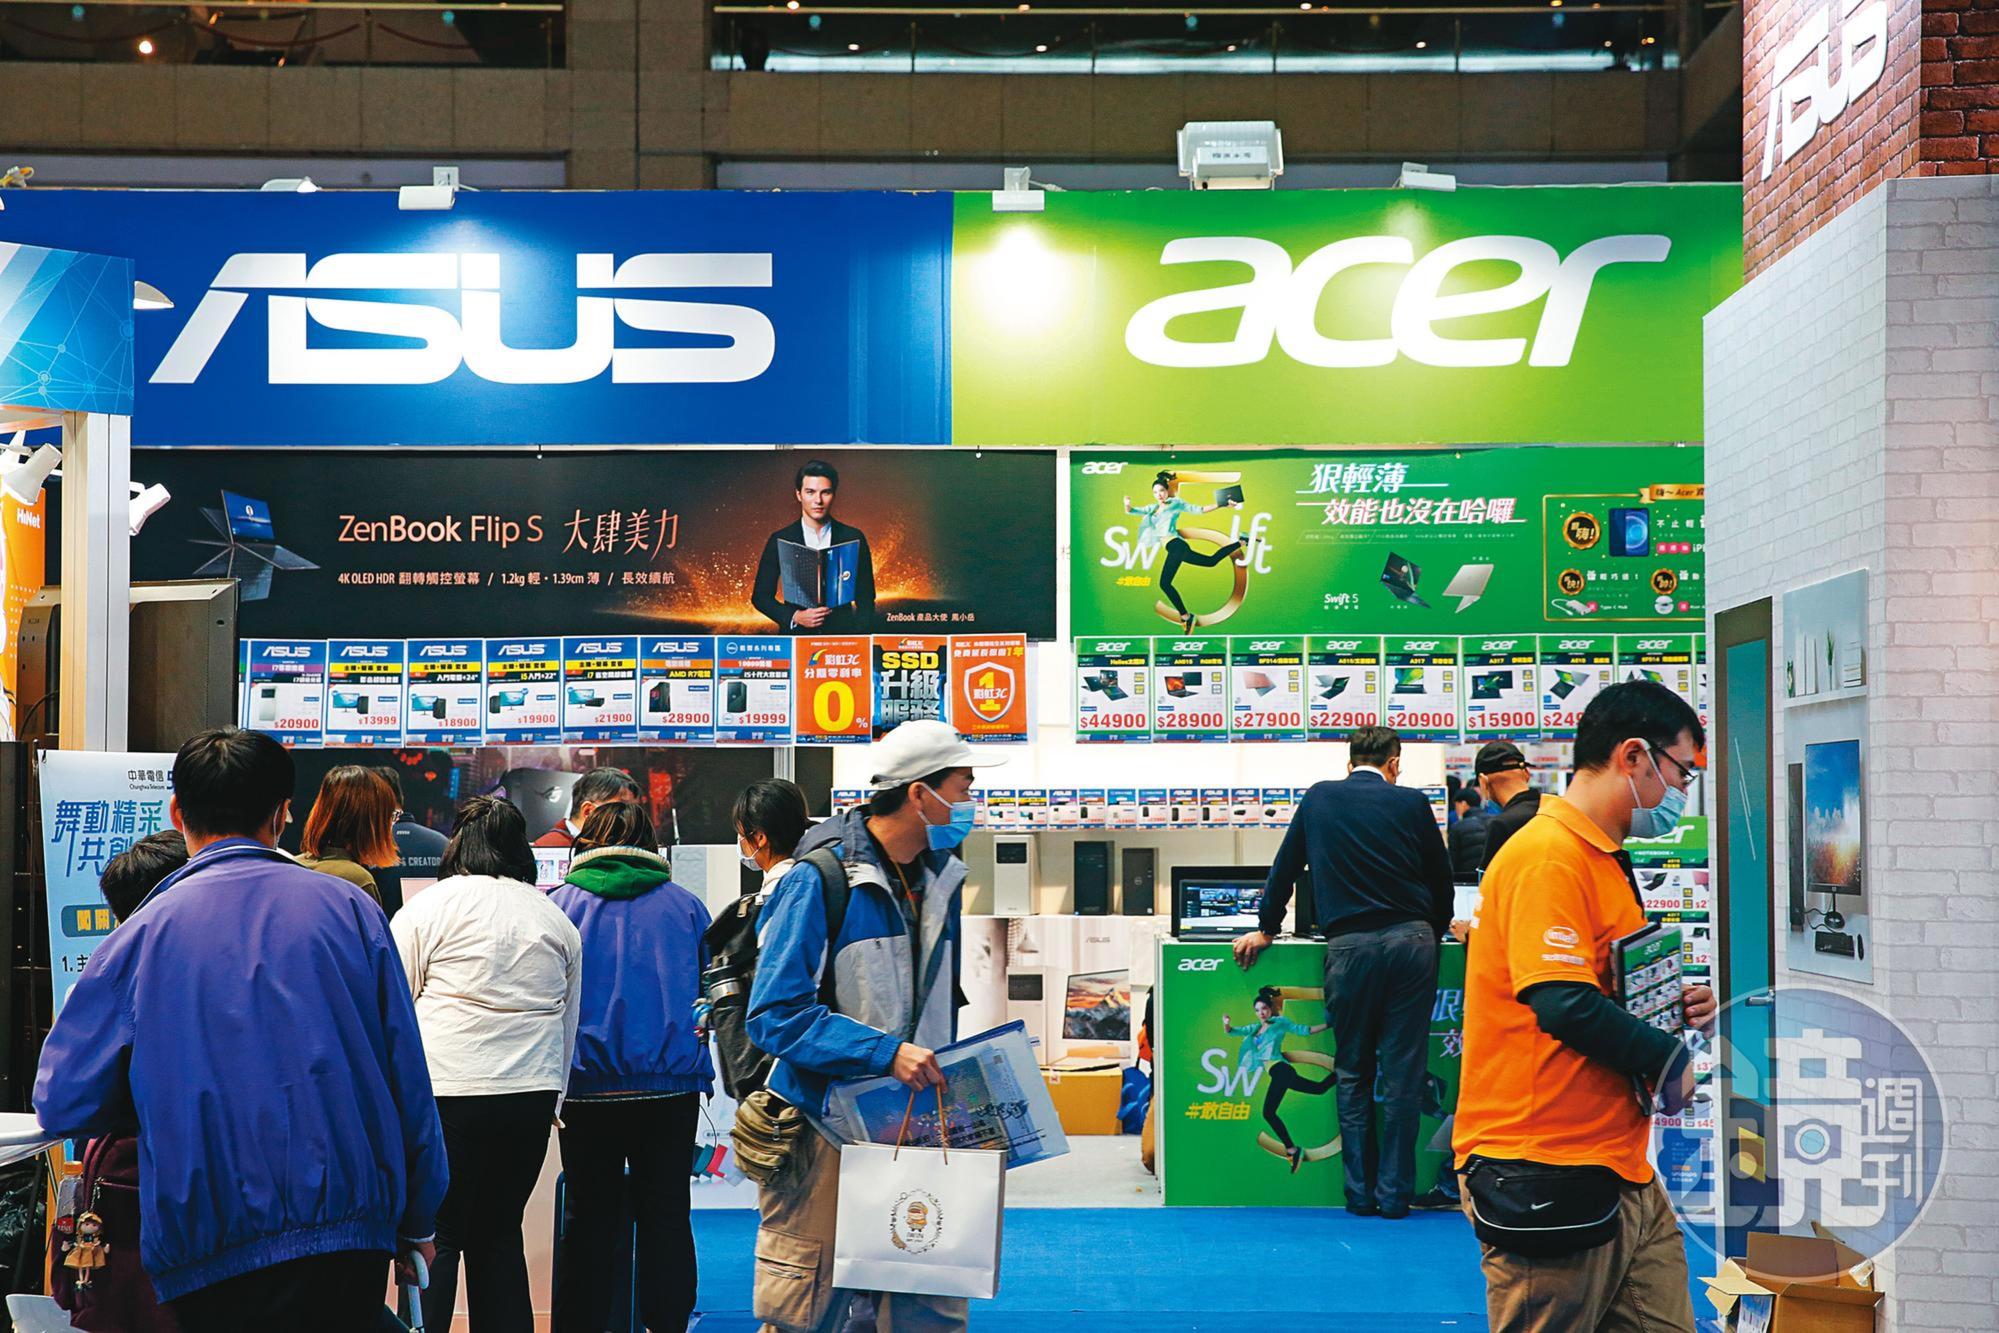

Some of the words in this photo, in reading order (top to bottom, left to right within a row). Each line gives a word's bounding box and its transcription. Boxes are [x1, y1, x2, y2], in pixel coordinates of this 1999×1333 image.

[1125, 234, 1672, 368] acer
[148, 253, 776, 385] ASUS
[1082, 461, 1128, 475] acer
[1321, 497, 1517, 525] 效能也沒在哈囉
[16, 508, 41, 529] HiNet
[338, 515, 461, 542] ZenBook
[471, 514, 520, 549] Flip
[527, 515, 543, 542] S
[563, 508, 679, 561] 大肆美力
[338, 574, 350, 584] 4K
[352, 574, 374, 584] OLED
[376, 574, 395, 584] HDR
[399, 572, 480, 585] 翻轉觸控螢幕
[501, 573, 525, 587] 1.2kg
[622, 573, 675, 585] 長效續航
[1324, 593, 1350, 604] Swift
[498, 644, 545, 655] ASUS
[575, 642, 622, 654] ASUS
[652, 642, 700, 653] ASUS
[1095, 642, 1131, 652] acer
[1172, 641, 1208, 651] acer
[1249, 641, 1285, 651] acer
[1326, 640, 1362, 650] acer
[1403, 641, 1440, 651] acer
[1481, 640, 1518, 650] acer
[1558, 639, 1595, 650] acer
[1637, 639, 1673, 650] acer
[262, 646, 311, 657] ASUS
[340, 646, 389, 657] ASUS
[419, 645, 468, 656] ASUS
[882, 652, 939, 669] SSD
[880, 670, 940, 699] 升級
[274, 718, 319, 729] $20900
[358, 716, 397, 725] $13999
[438, 718, 477, 727] $18900
[517, 714, 556, 724] $19900
[594, 713, 632, 723] $21900
[662, 713, 710, 724] $28900
[738, 713, 786, 724] $19999
[1080, 713, 1146, 729] $44900
[1157, 713, 1223, 728] $28900
[1234, 712, 1300, 728] $27900
[1388, 712, 1455, 728] $20900
[1468, 711, 1535, 729] $15900
[128, 770, 164, 782] 中華電信
[1177, 958, 1224, 971] acer
[1184, 1101, 1250, 1121] #敢自由
